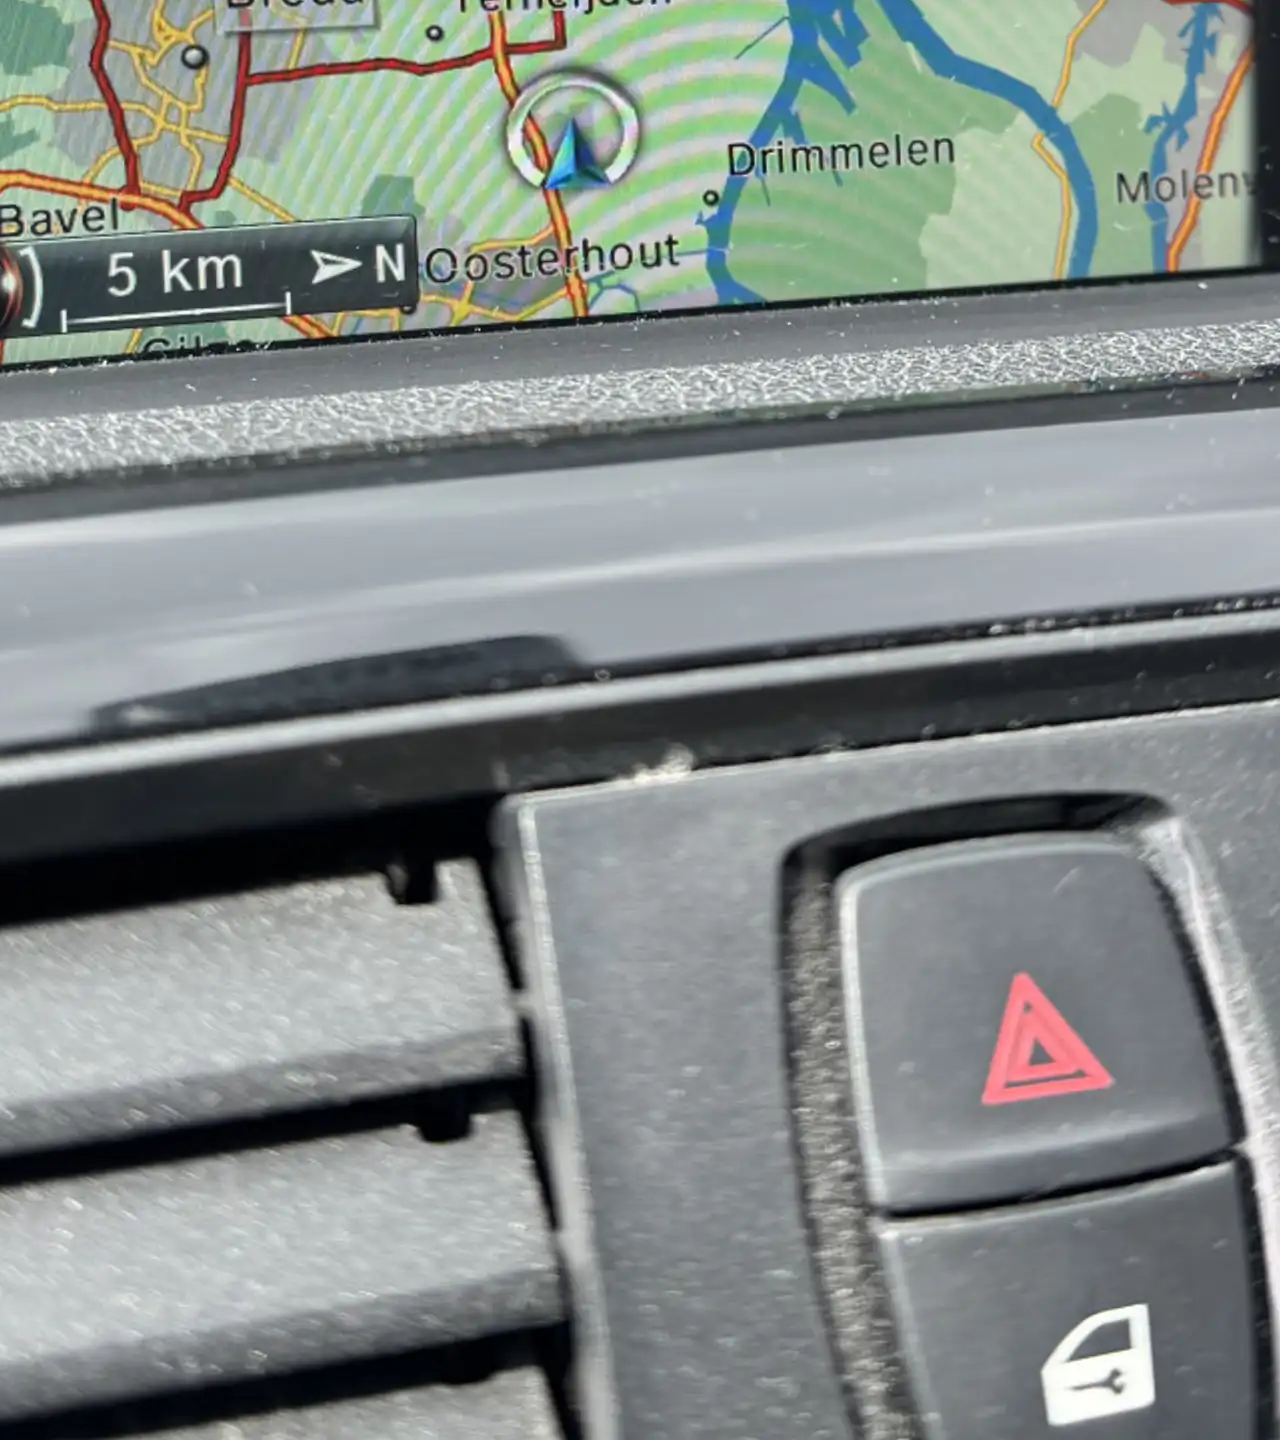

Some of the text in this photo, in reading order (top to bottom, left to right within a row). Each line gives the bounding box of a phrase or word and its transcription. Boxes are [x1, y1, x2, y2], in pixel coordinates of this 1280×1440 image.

[728, 134, 955, 176] Drimmelen
[107, 250, 243, 297] 5 km
[374, 244, 406, 283] N
[425, 233, 679, 283] Oosterhout
